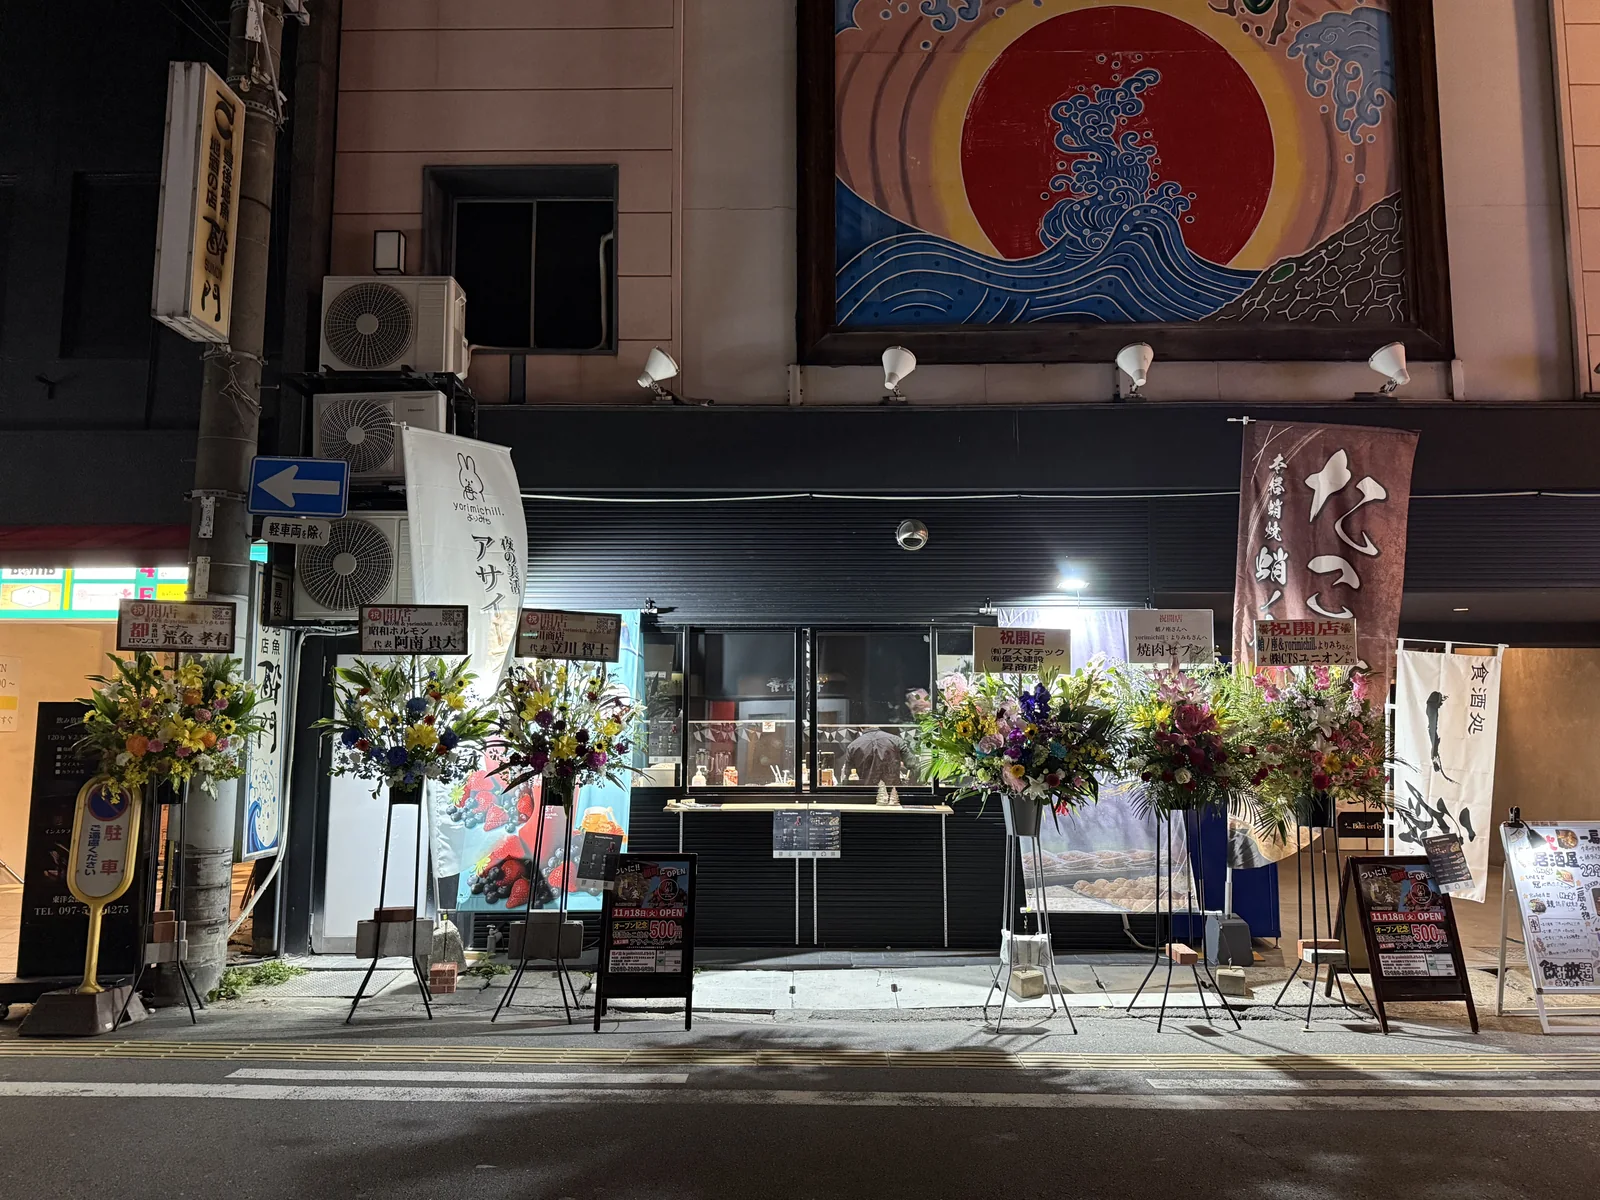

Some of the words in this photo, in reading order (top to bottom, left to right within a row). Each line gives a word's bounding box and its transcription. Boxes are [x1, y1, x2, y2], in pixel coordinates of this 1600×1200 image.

[452, 500, 505, 517] yorimichill.
[268, 522, 323, 540] 軽車両を除く
[130, 603, 178, 619] 祝開店
[367, 607, 413, 624] 祝開店
[1159, 614, 1183, 623] 祝開店
[526, 612, 568, 628] 祝開店
[368, 626, 430, 636] 昭和ホルモン
[1269, 620, 1341, 637] 祝開店
[162, 629, 194, 645] 荒金
[198, 630, 230, 647] 孝有
[373, 640, 392, 648] 代表
[394, 635, 424, 650] 阿南
[428, 635, 458, 650] 貴大
[999, 629, 1047, 646] 祝開店
[529, 643, 548, 653] 代表
[551, 641, 577, 656] 立川
[581, 642, 609, 657] 智士
[1136, 642, 1206, 657] 焼肉セブン
[1467, 661, 1490, 736] 食酒処
[84, 824, 102, 877] ご遠慮ください
[100, 824, 123, 876] 駐車
[667, 867, 687, 878] OPEN
[1360, 867, 1388, 879] ついに!!
[34, 907, 54, 916] TEL
[659, 908, 683, 917] OPEN
[1417, 912, 1442, 921] OPEN
[614, 921, 648, 930] オープン記念
[1375, 924, 1410, 934] オープン記念
